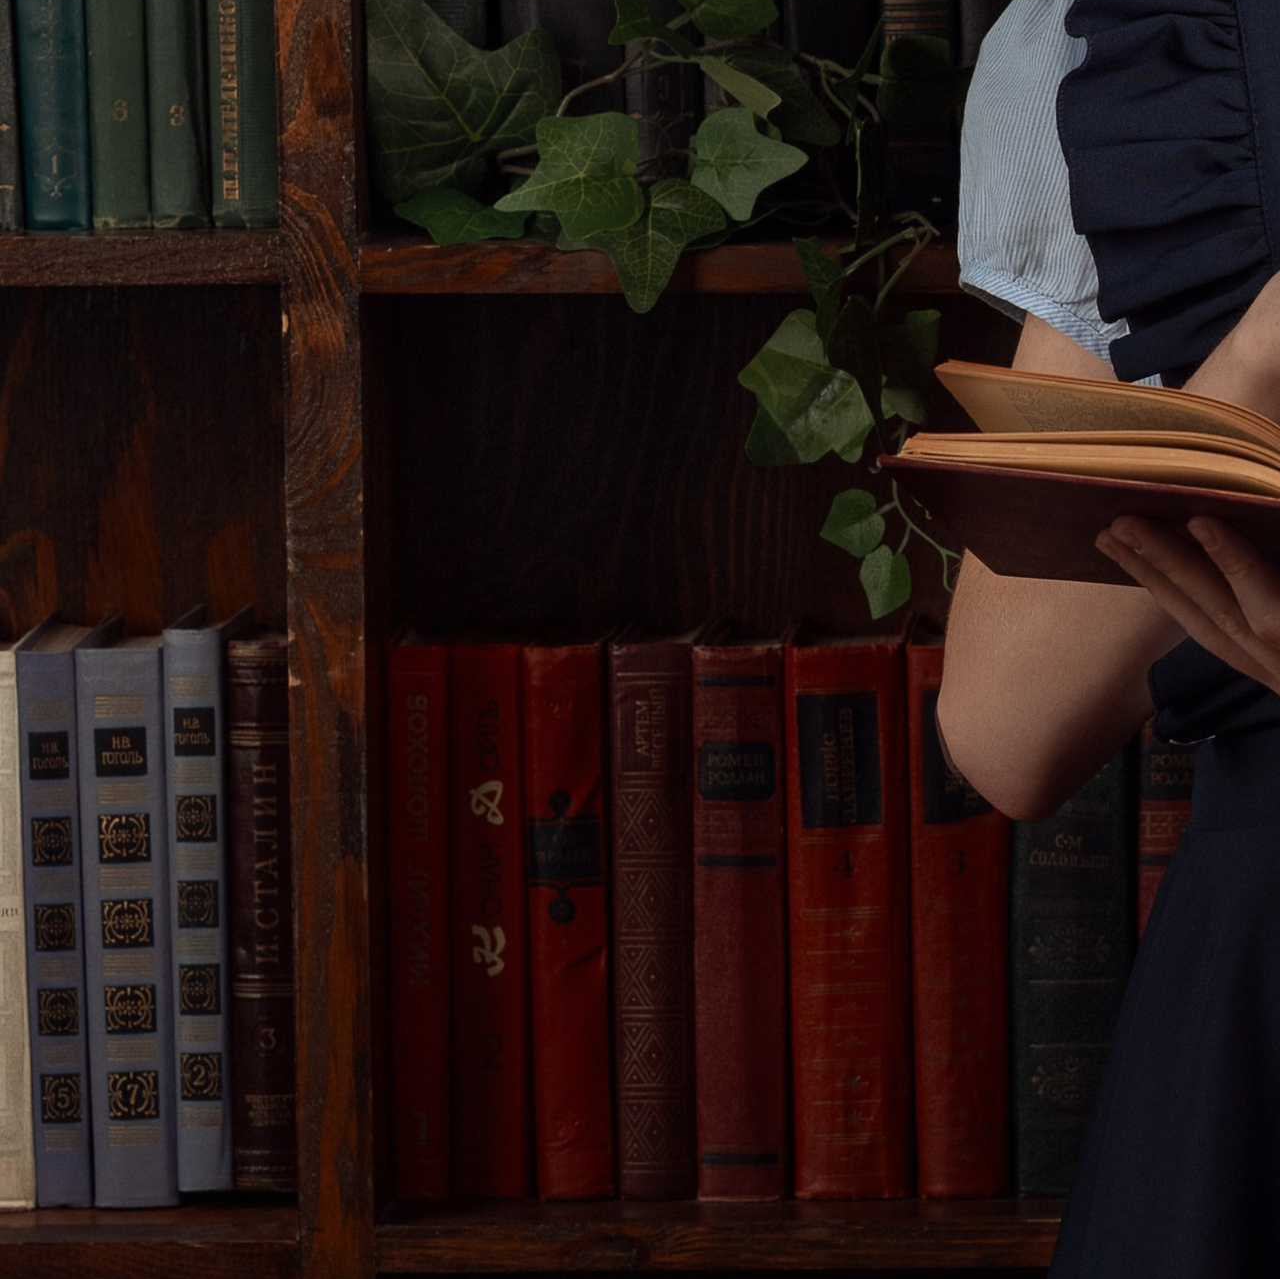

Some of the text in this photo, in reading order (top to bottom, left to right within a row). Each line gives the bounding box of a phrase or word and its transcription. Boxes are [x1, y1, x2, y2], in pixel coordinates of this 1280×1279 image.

[111, 99, 128, 123] 6
[169, 104, 187, 128] 3
[50, 155, 59, 175] 1
[634, 699, 652, 758] АРТЕМ
[112, 735, 132, 750] Н.В.
[706, 752, 765, 768] РОМЕН
[707, 770, 766, 786] РОЛЛАН
[404, 692, 432, 986] МИХАИЛ ШОЛОХОВ
[1029, 850, 1111, 870] СОЛОВЬЕВ
[260, 1027, 277, 1049] 3
[192, 1064, 207, 1087] 2
[57, 1087, 71, 1109] 5
[127, 1082, 141, 1105] 7
